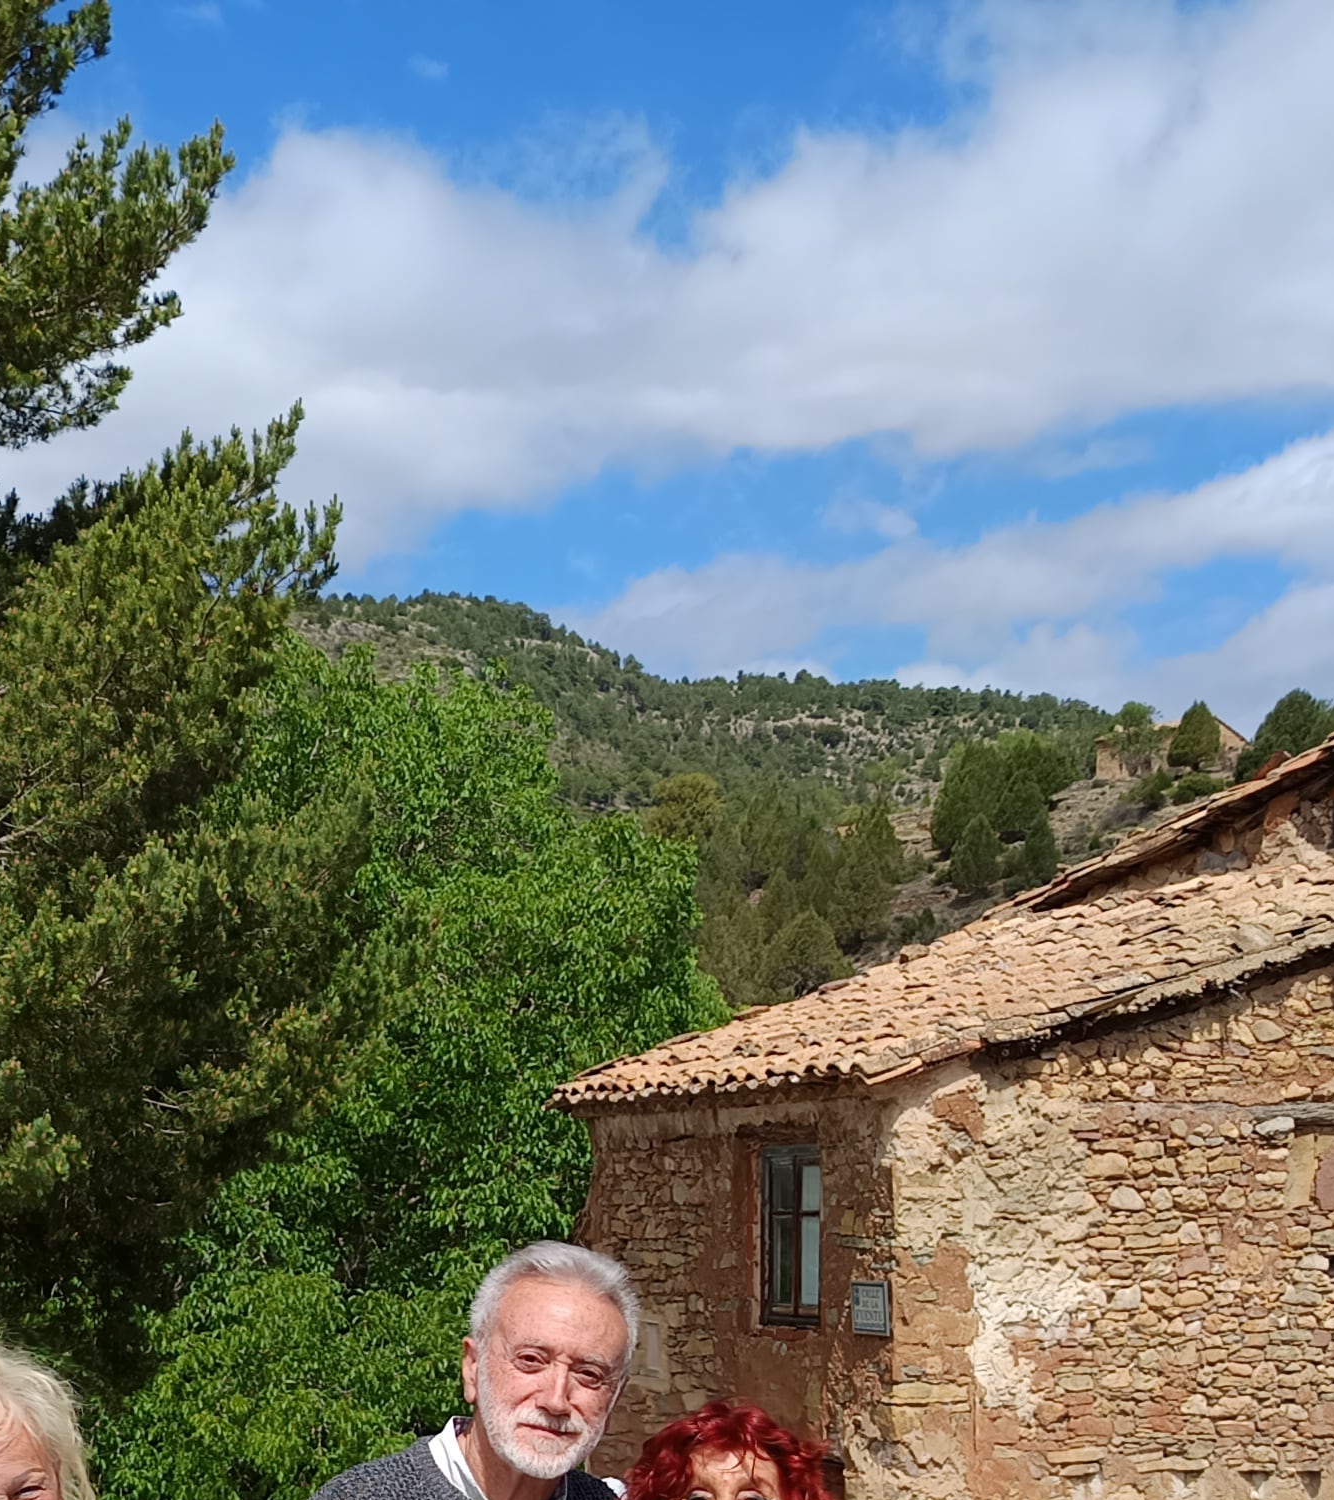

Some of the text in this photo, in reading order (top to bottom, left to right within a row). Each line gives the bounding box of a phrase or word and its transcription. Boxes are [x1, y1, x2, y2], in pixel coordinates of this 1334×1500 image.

[861, 1288, 880, 1298] CALLE
[862, 1299, 879, 1308] DE LA
[856, 1310, 883, 1321] FUENTE
